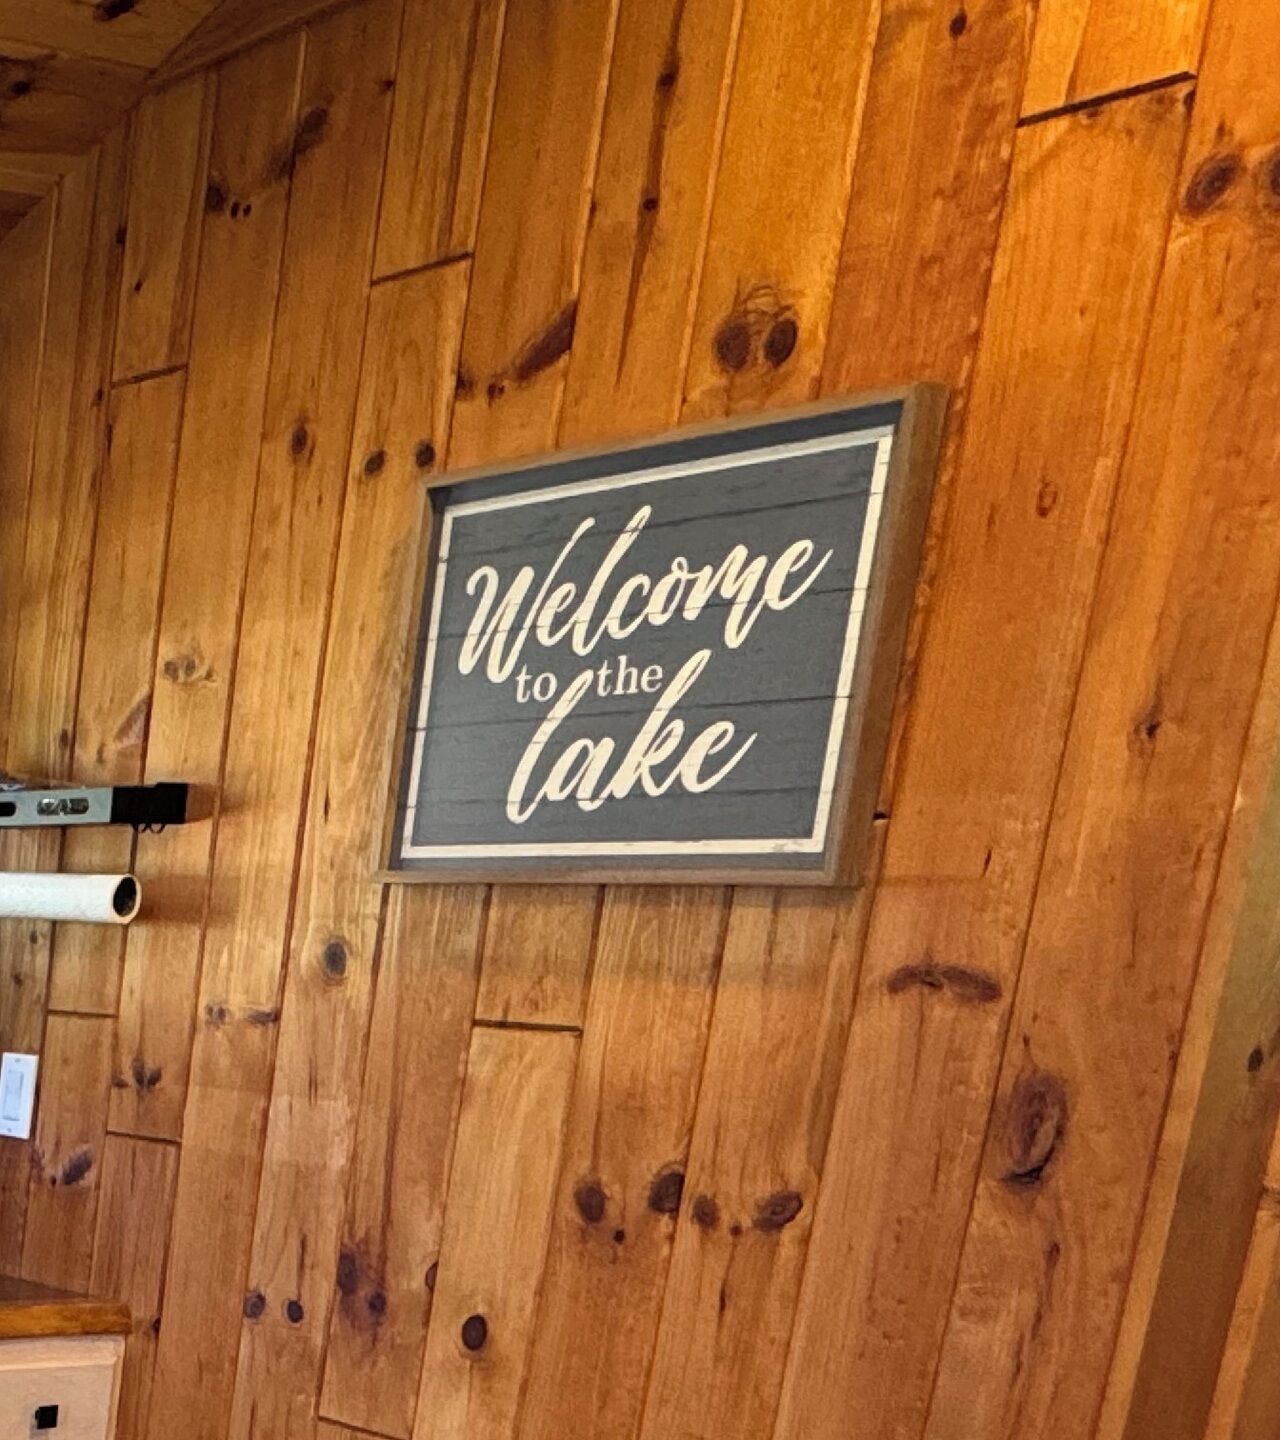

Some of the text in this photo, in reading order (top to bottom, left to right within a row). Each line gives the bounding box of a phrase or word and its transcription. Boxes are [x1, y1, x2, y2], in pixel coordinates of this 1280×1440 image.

[458, 504, 834, 683] Welcome
[515, 655, 664, 703] to the
